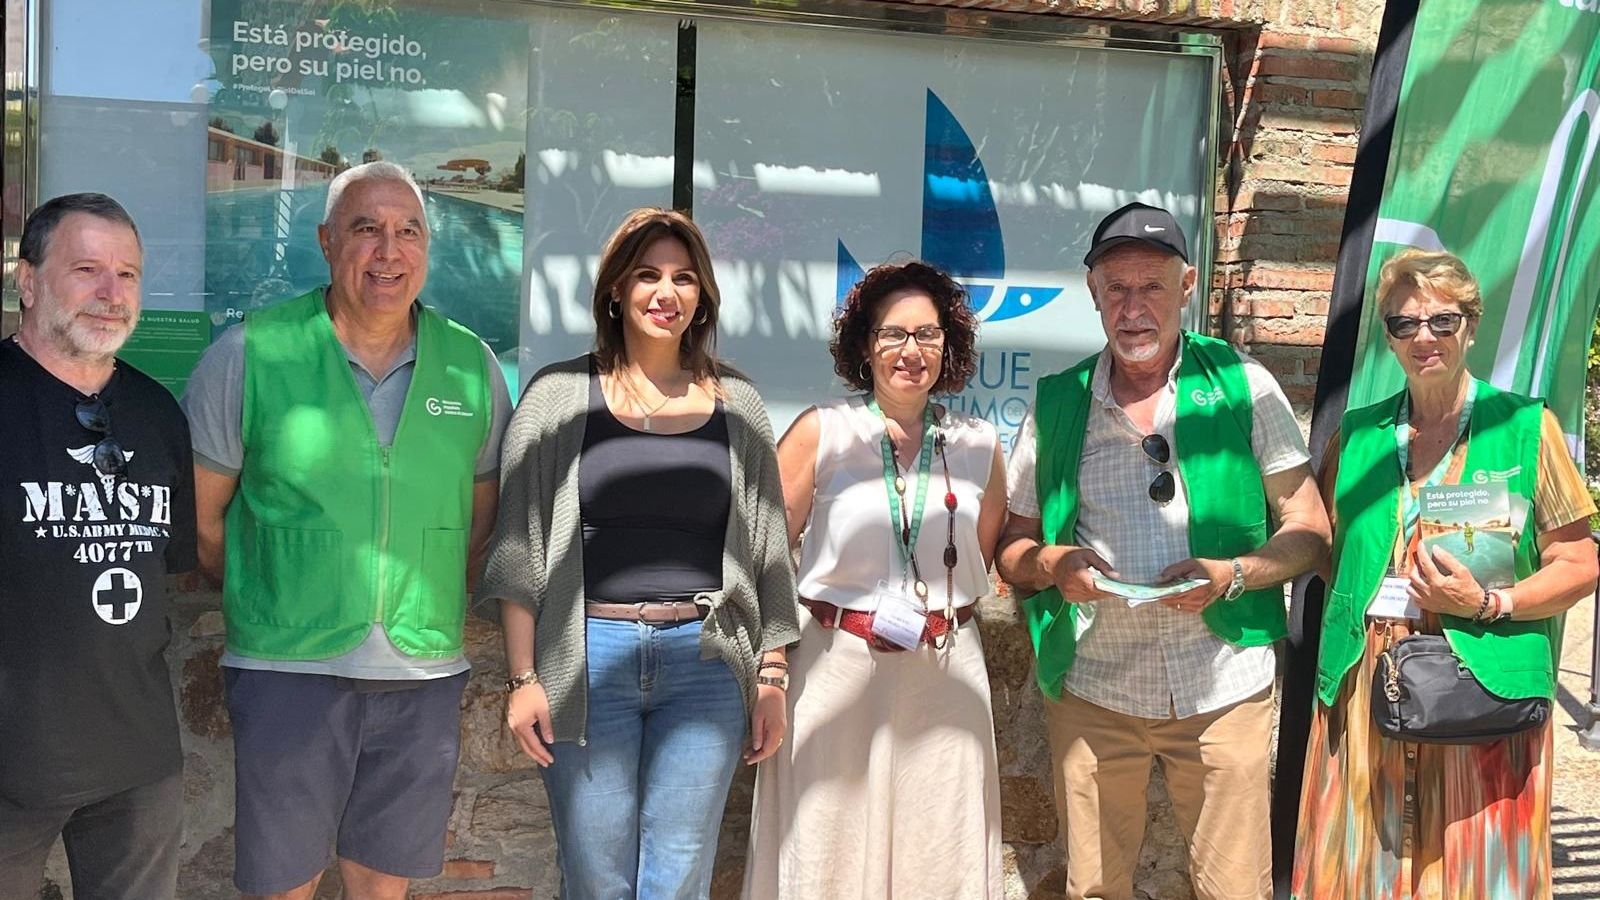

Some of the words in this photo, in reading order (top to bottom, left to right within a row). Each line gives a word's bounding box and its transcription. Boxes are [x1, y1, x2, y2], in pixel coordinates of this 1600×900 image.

[233, 20, 289, 46] Está
[295, 29, 427, 60] protegido,
[232, 53, 293, 76] pero
[299, 58, 329, 77] su
[336, 58, 384, 83] piel
[226, 307, 244, 319] Re
[966, 351, 1032, 390] UE
[937, 394, 1029, 428] TIMO
[1426, 492, 1445, 500] Está
[1446, 489, 1490, 500] protegido,
[1427, 501, 1447, 509] pero
[1460, 498, 1476, 507] piel
[52, 525, 81, 539] U.S.
[82, 524, 126, 538] ARMY
[128, 523, 161, 538] MEDIC
